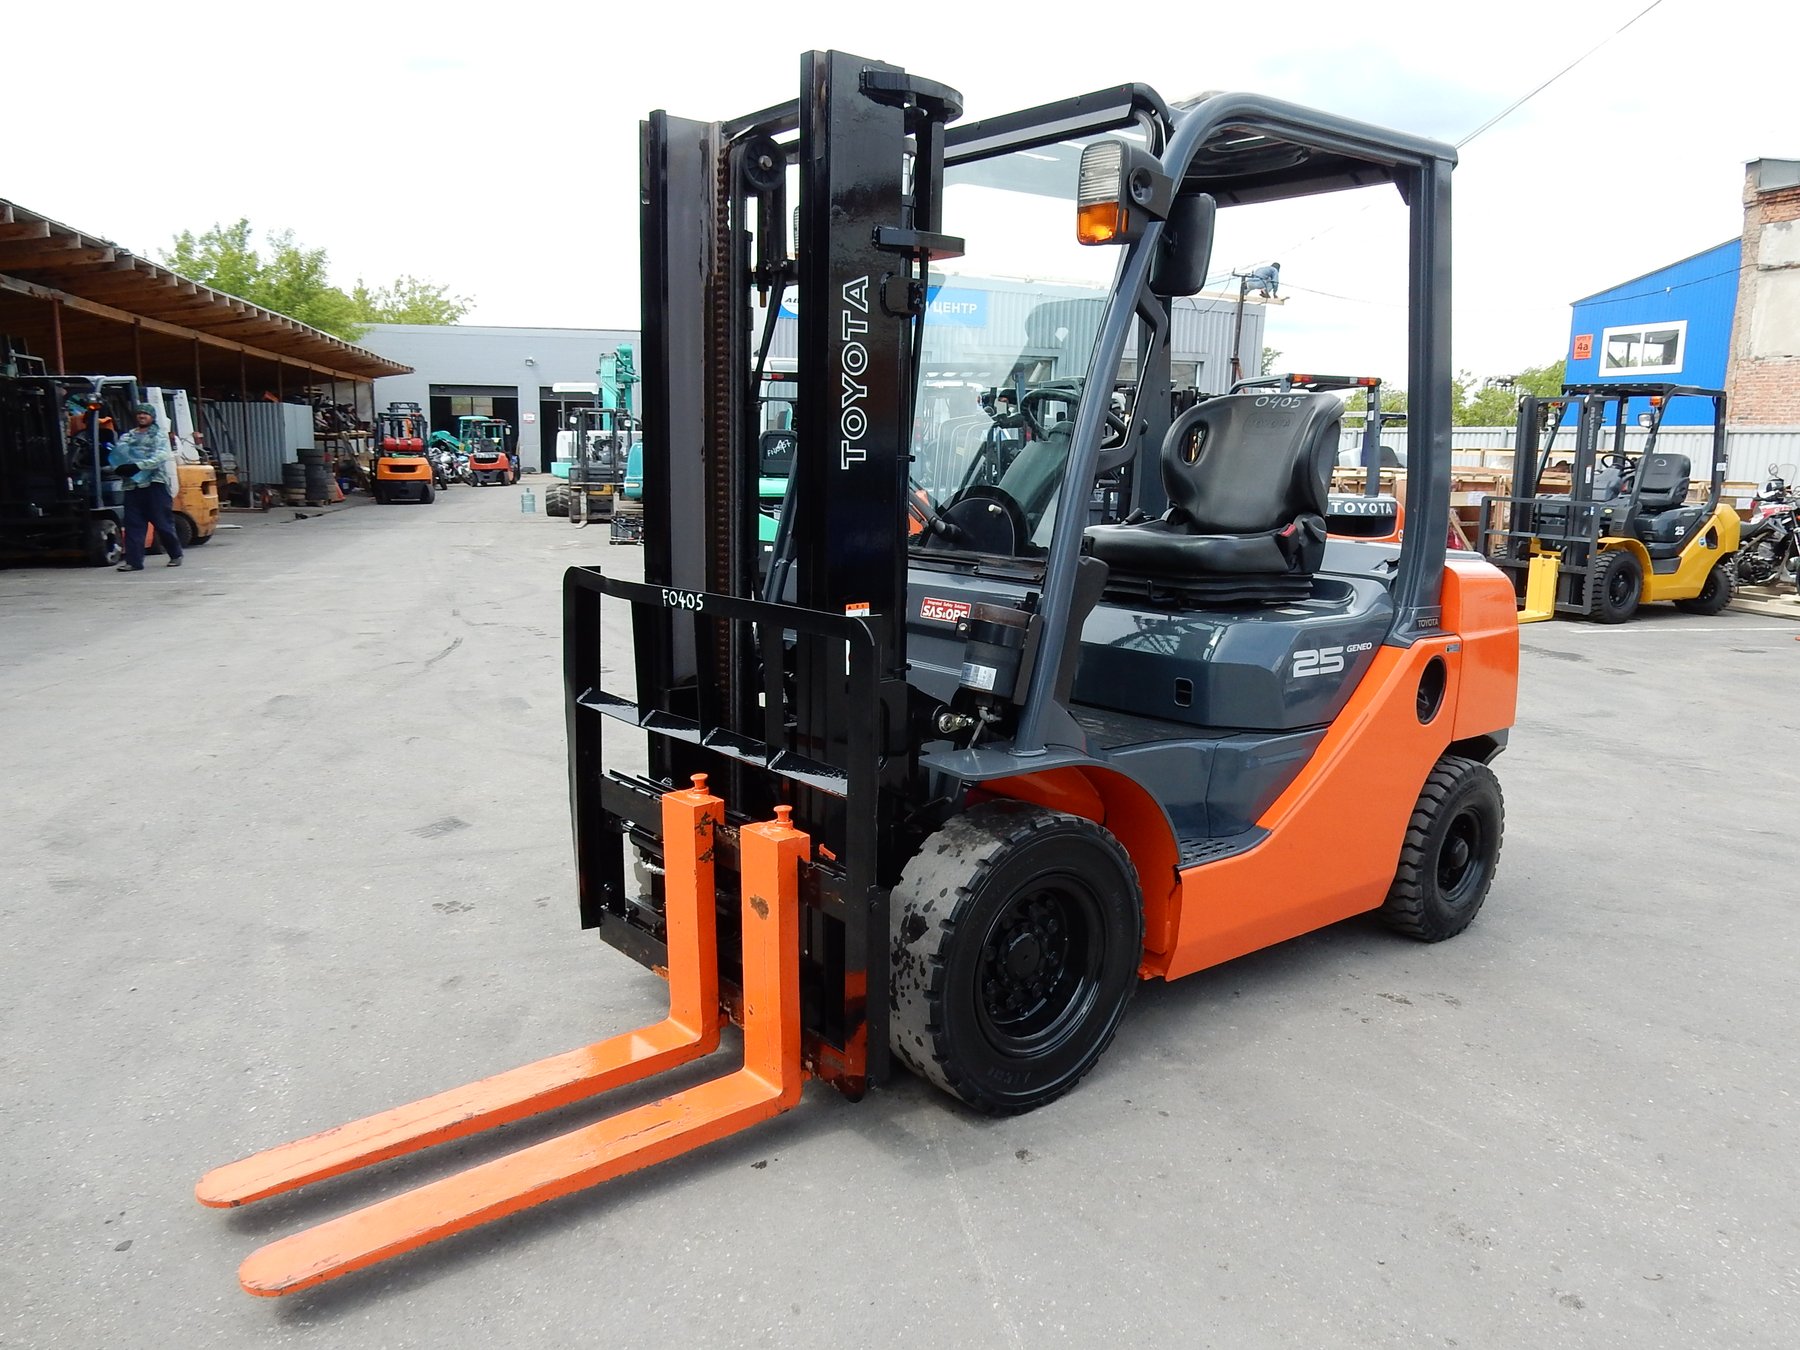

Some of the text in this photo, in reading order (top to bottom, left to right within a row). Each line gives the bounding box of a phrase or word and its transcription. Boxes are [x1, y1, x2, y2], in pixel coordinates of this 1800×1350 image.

[933, 301, 977, 315] ЦЕНТР
[841, 275, 869, 470] TOYOTA
[1255, 396, 1307, 409] 0405
[1331, 502, 1392, 514] TOYOTA
[1674, 526, 1685, 536] 25
[1418, 618, 1439, 628] TOYOTA
[1293, 642, 1373, 678] 25 GENEO
